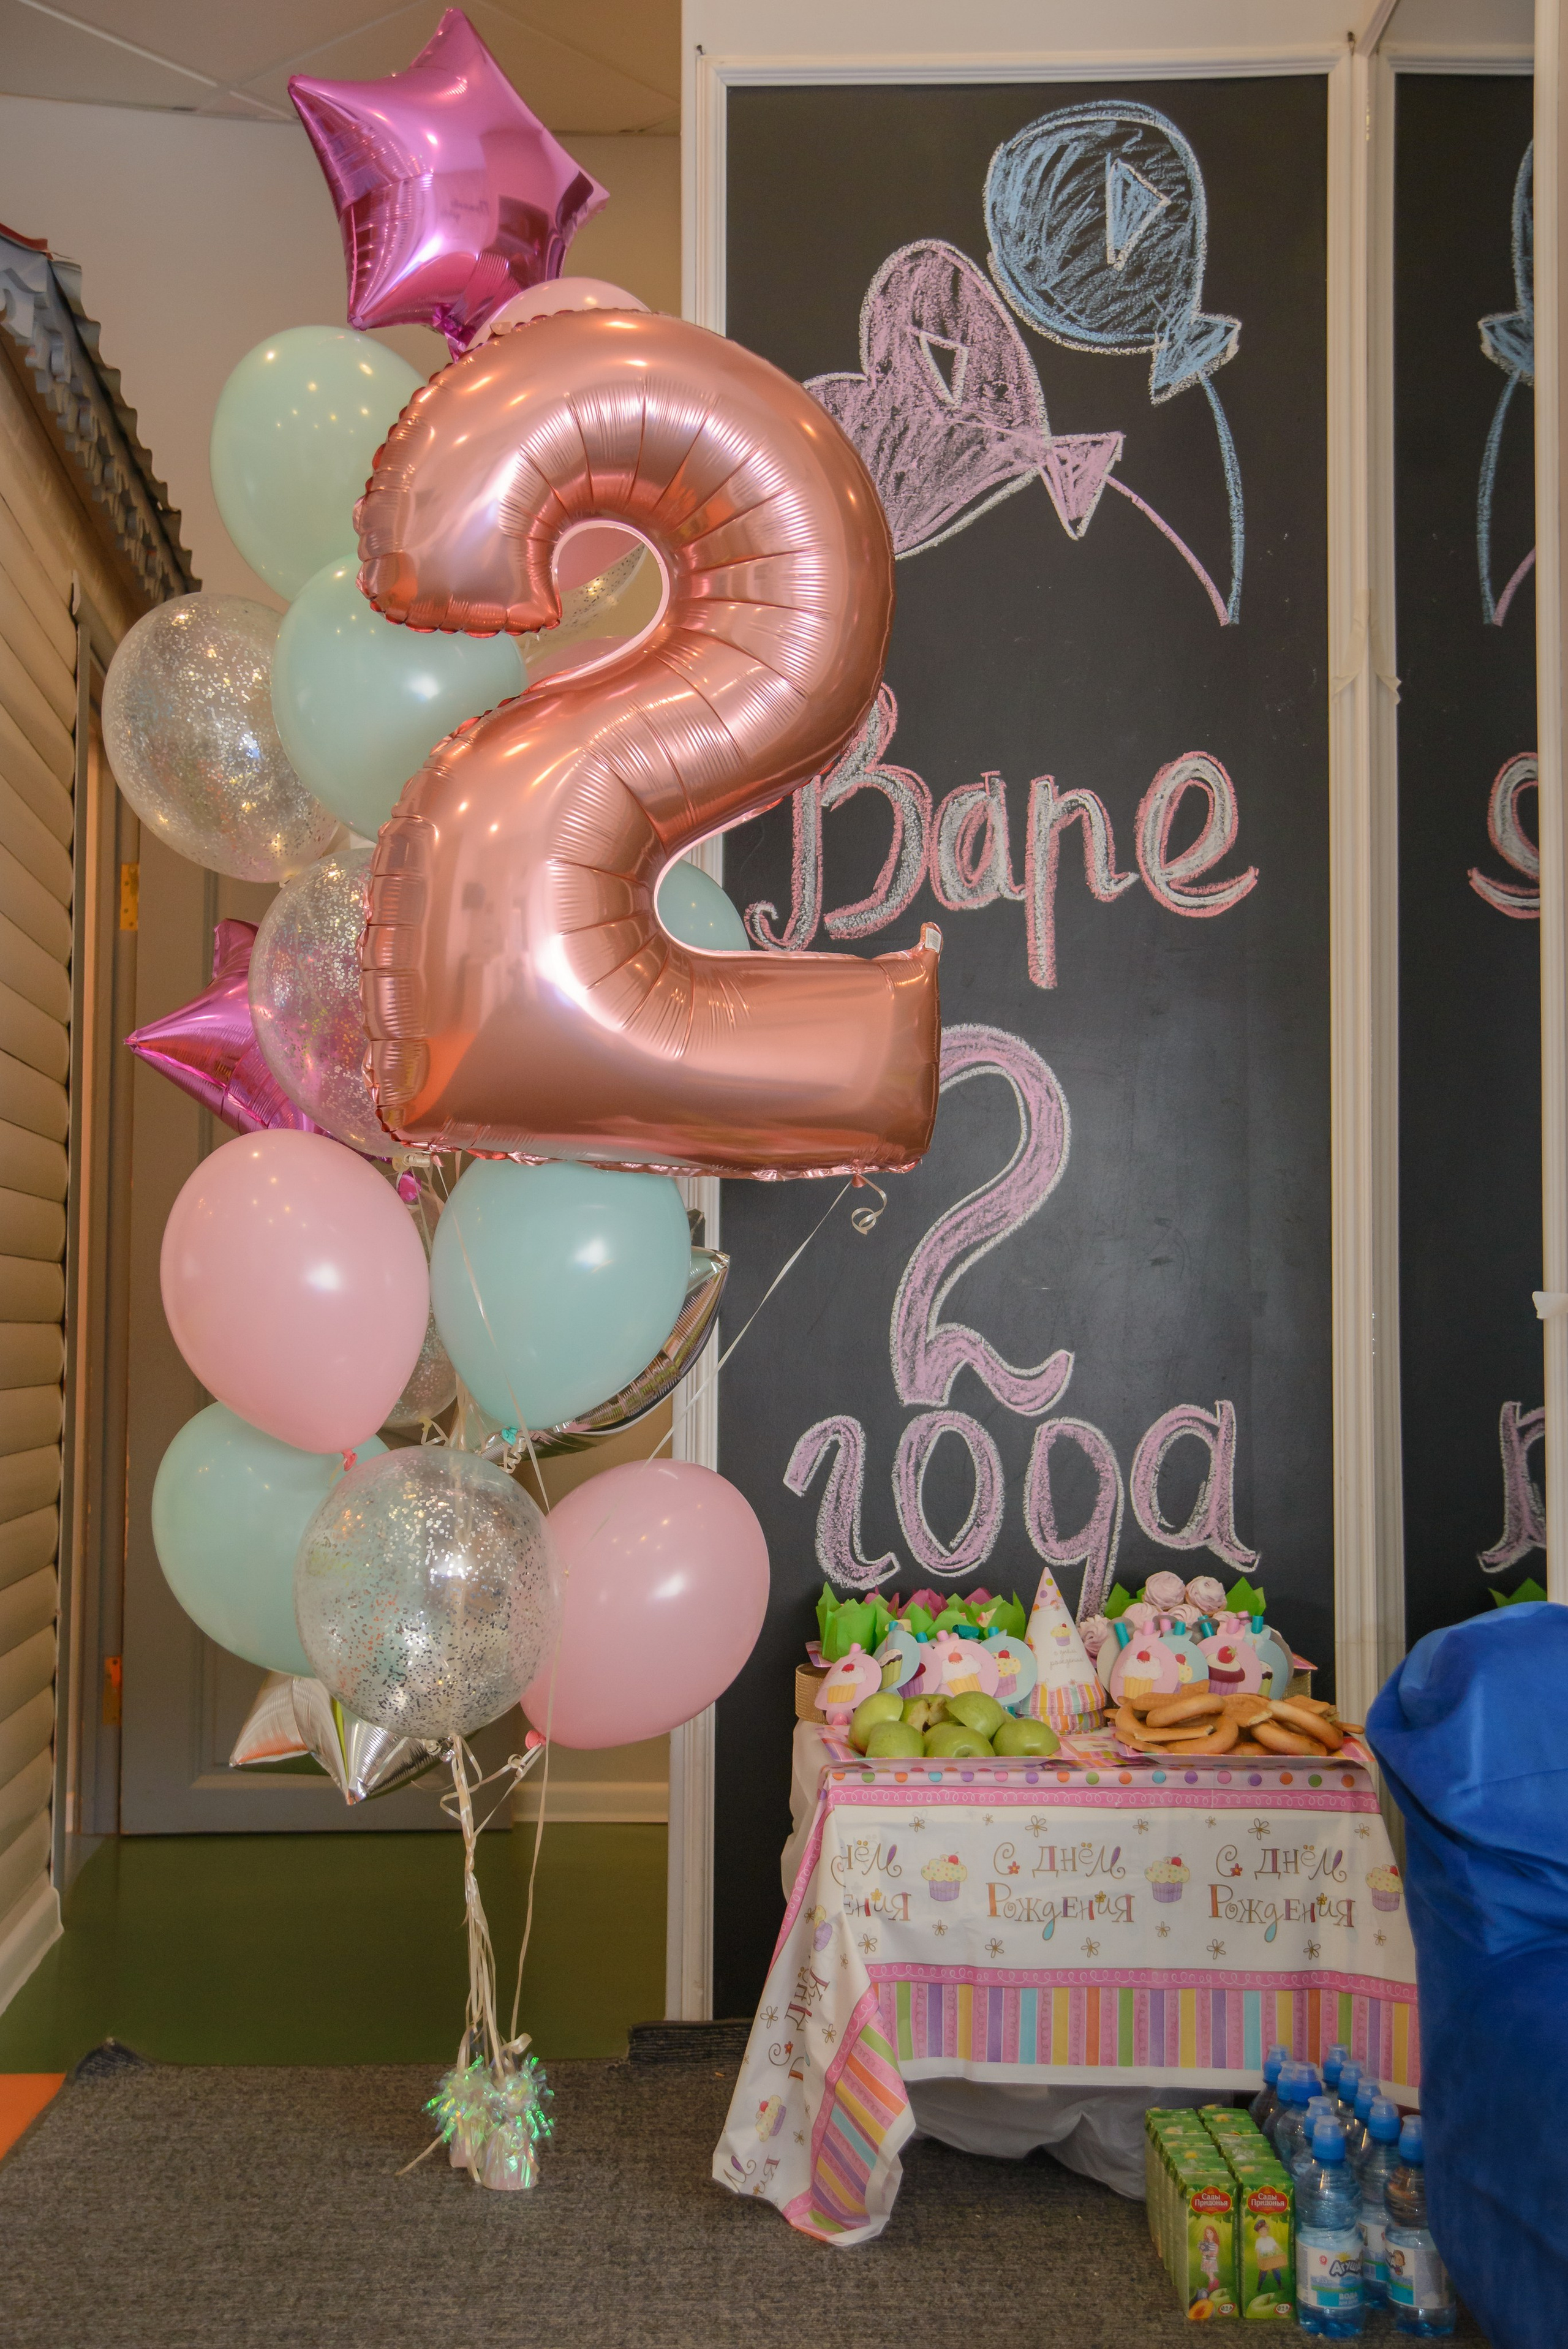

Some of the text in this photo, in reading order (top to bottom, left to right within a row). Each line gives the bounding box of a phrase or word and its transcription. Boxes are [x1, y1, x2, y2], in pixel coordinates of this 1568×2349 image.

[889, 1022, 1075, 1416] 2
[783, 1400, 1261, 1626] года
[1194, 2199, 1228, 2208] Придонья
[1251, 2199, 1285, 2208] Придонья
